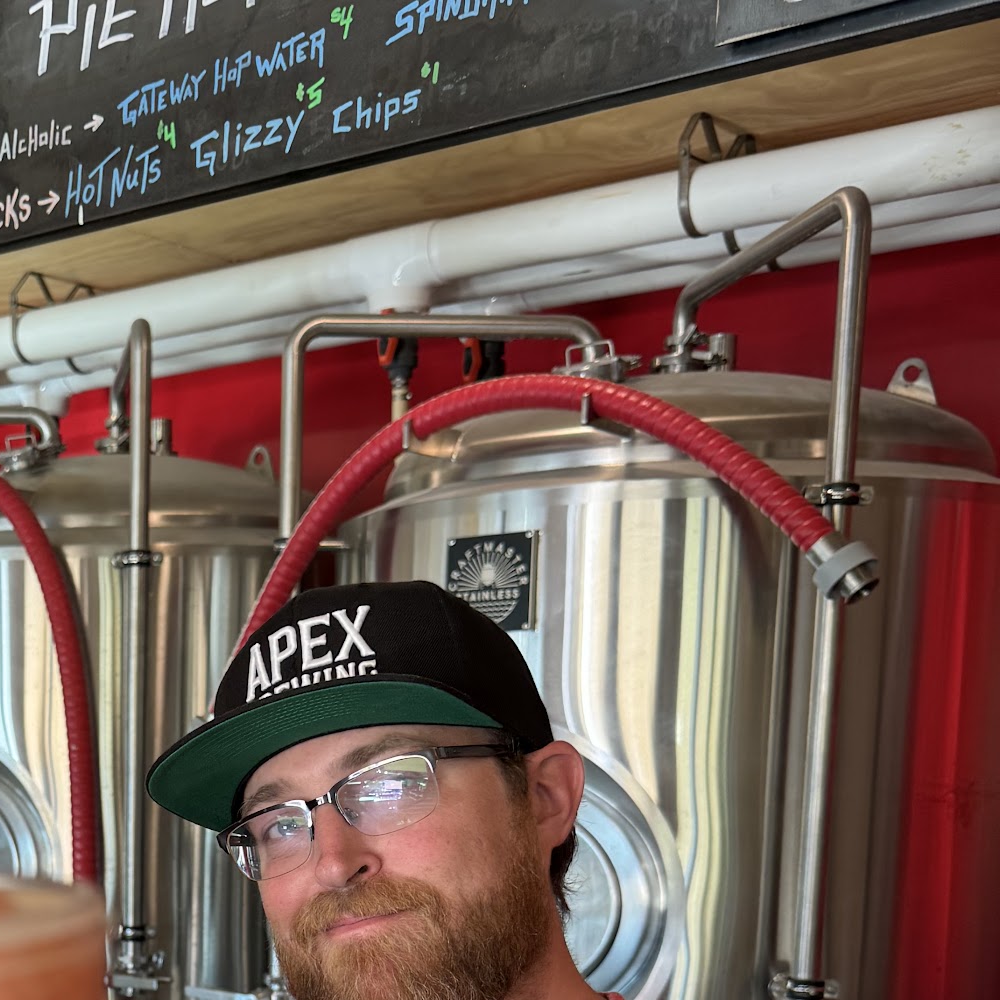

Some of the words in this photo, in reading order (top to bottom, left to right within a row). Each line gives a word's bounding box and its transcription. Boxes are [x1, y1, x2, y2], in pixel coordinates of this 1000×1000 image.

[117, 69, 207, 127] GATEWAY
[256, 28, 326, 77] WATER
[190, 110, 305, 176] Glizzy
[332, 89, 421, 134] Chips
[447, 541, 528, 592] CRAFTMASTER
[246, 604, 376, 703] APEX
